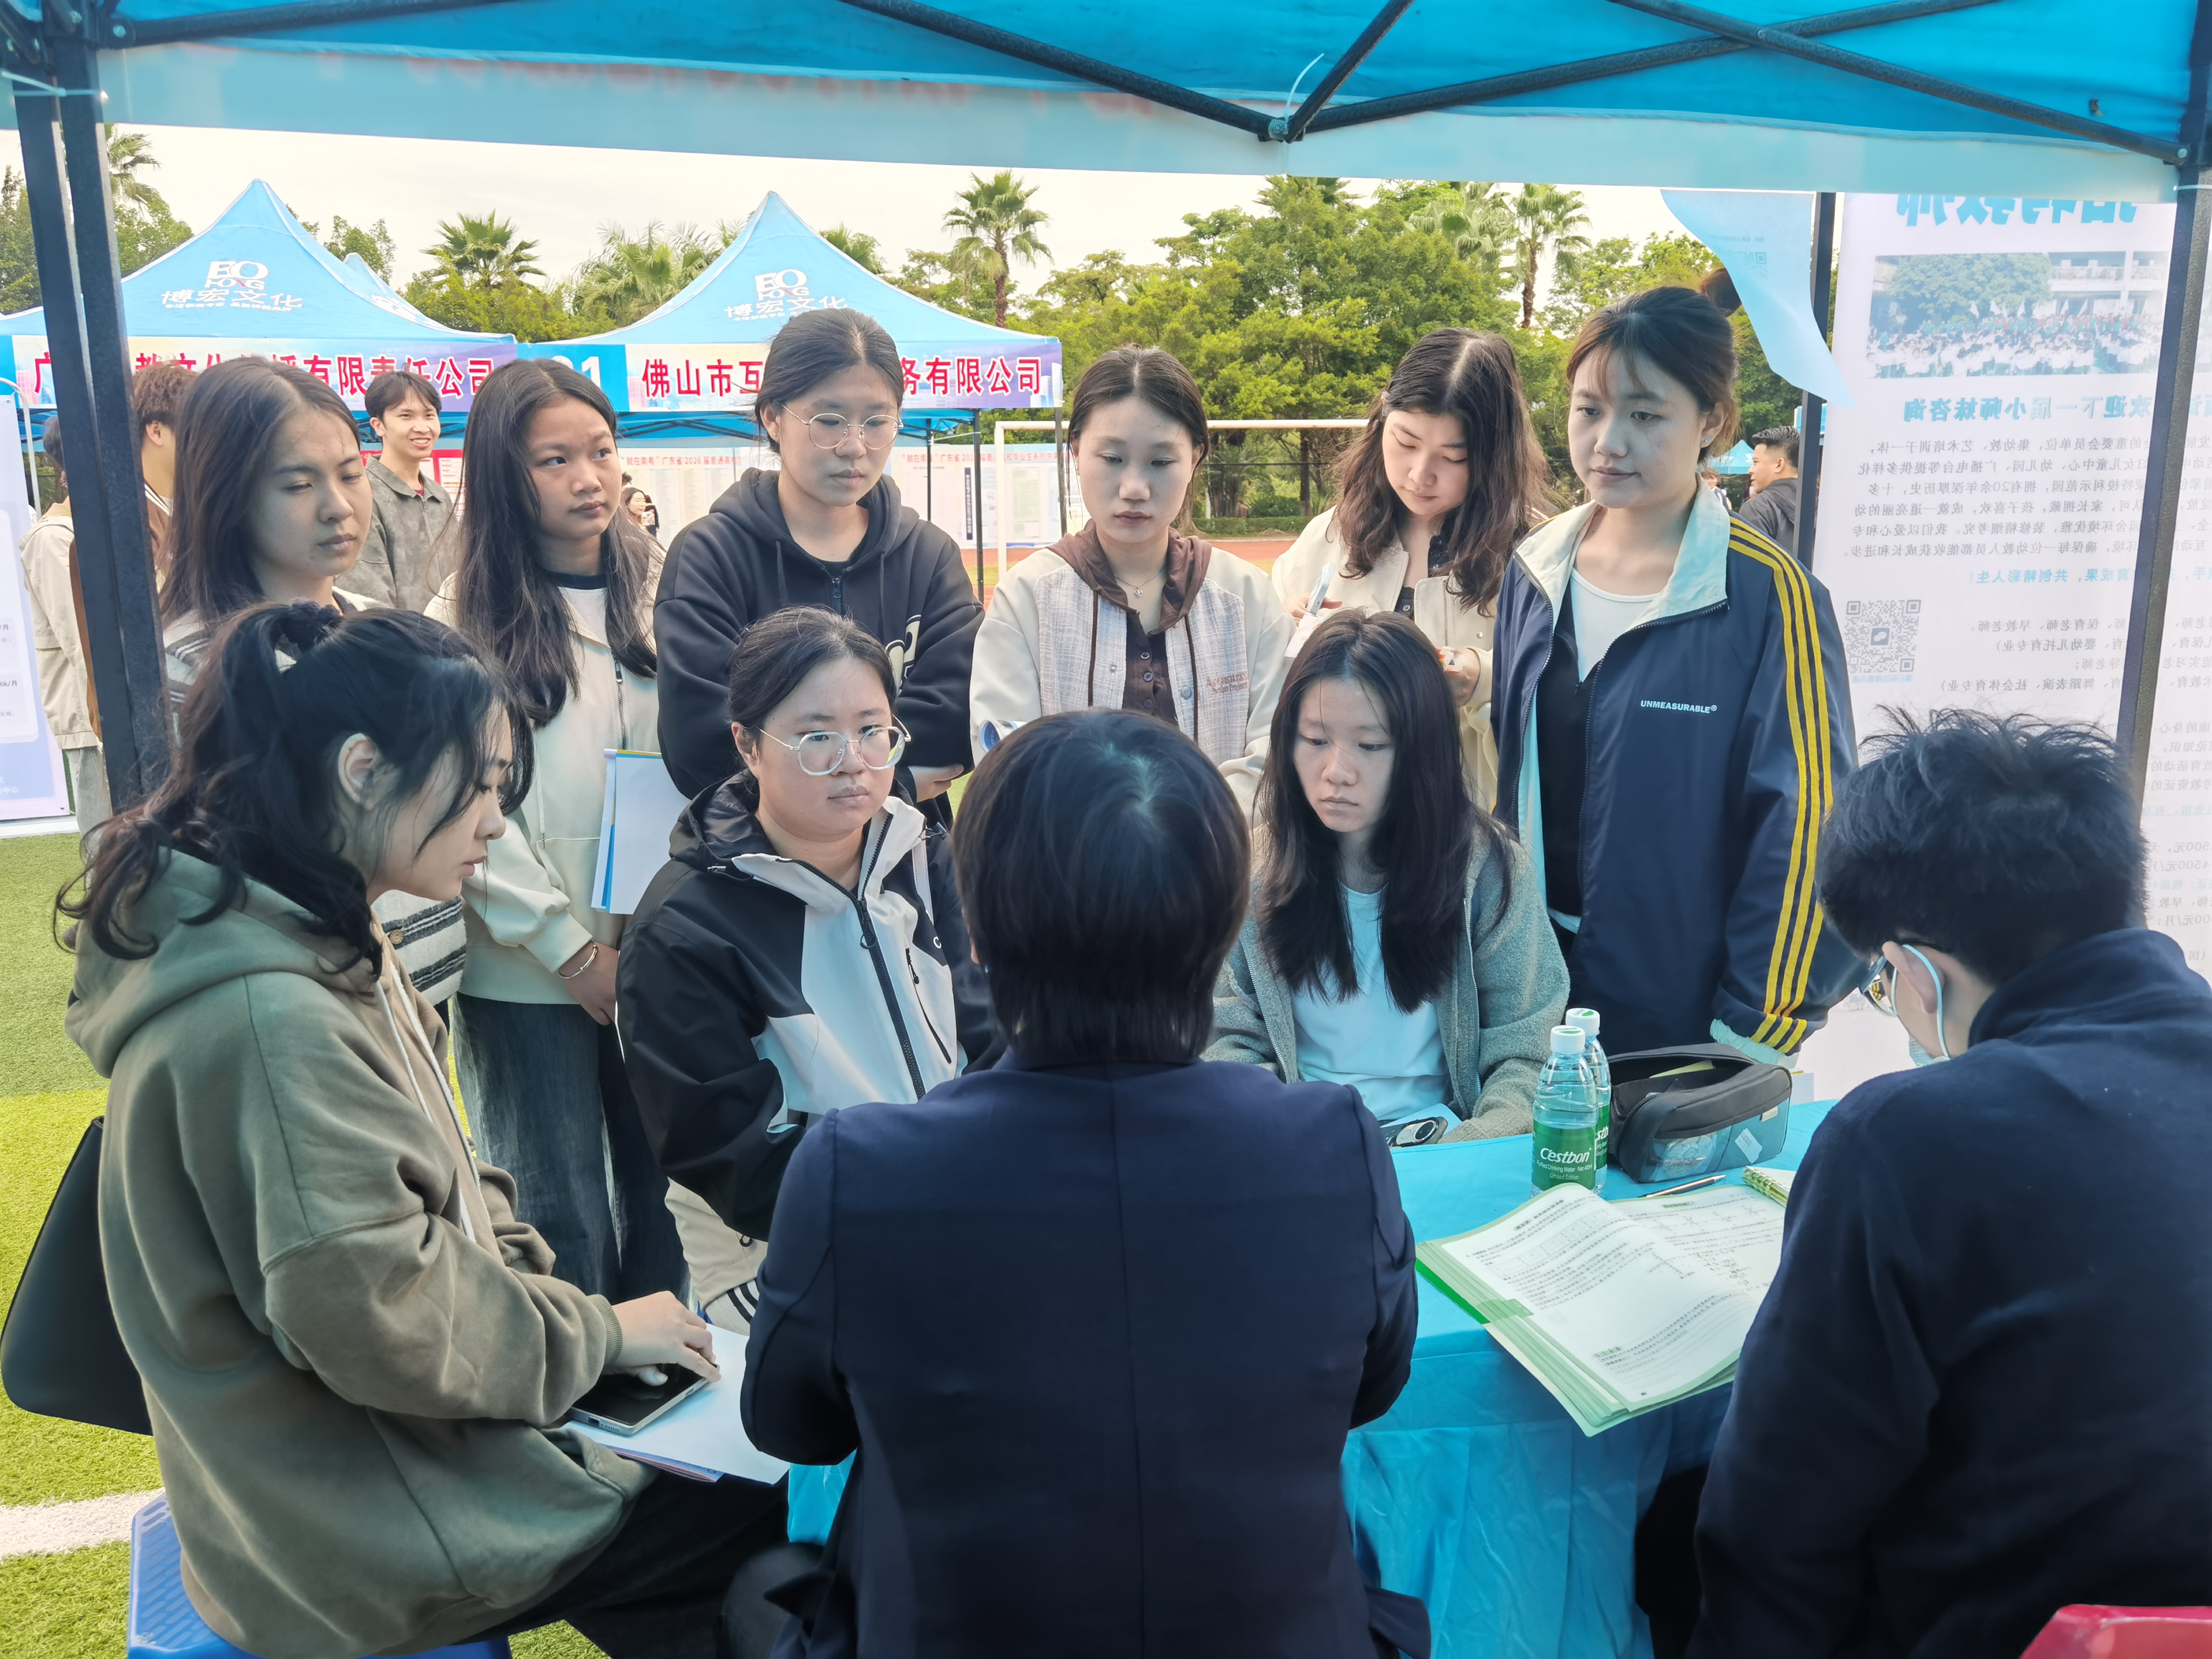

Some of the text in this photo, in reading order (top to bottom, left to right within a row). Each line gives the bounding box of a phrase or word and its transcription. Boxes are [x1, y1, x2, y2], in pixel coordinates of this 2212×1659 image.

[160, 288, 304, 308] 博宏文化
[724, 295, 848, 318] 博宏文化
